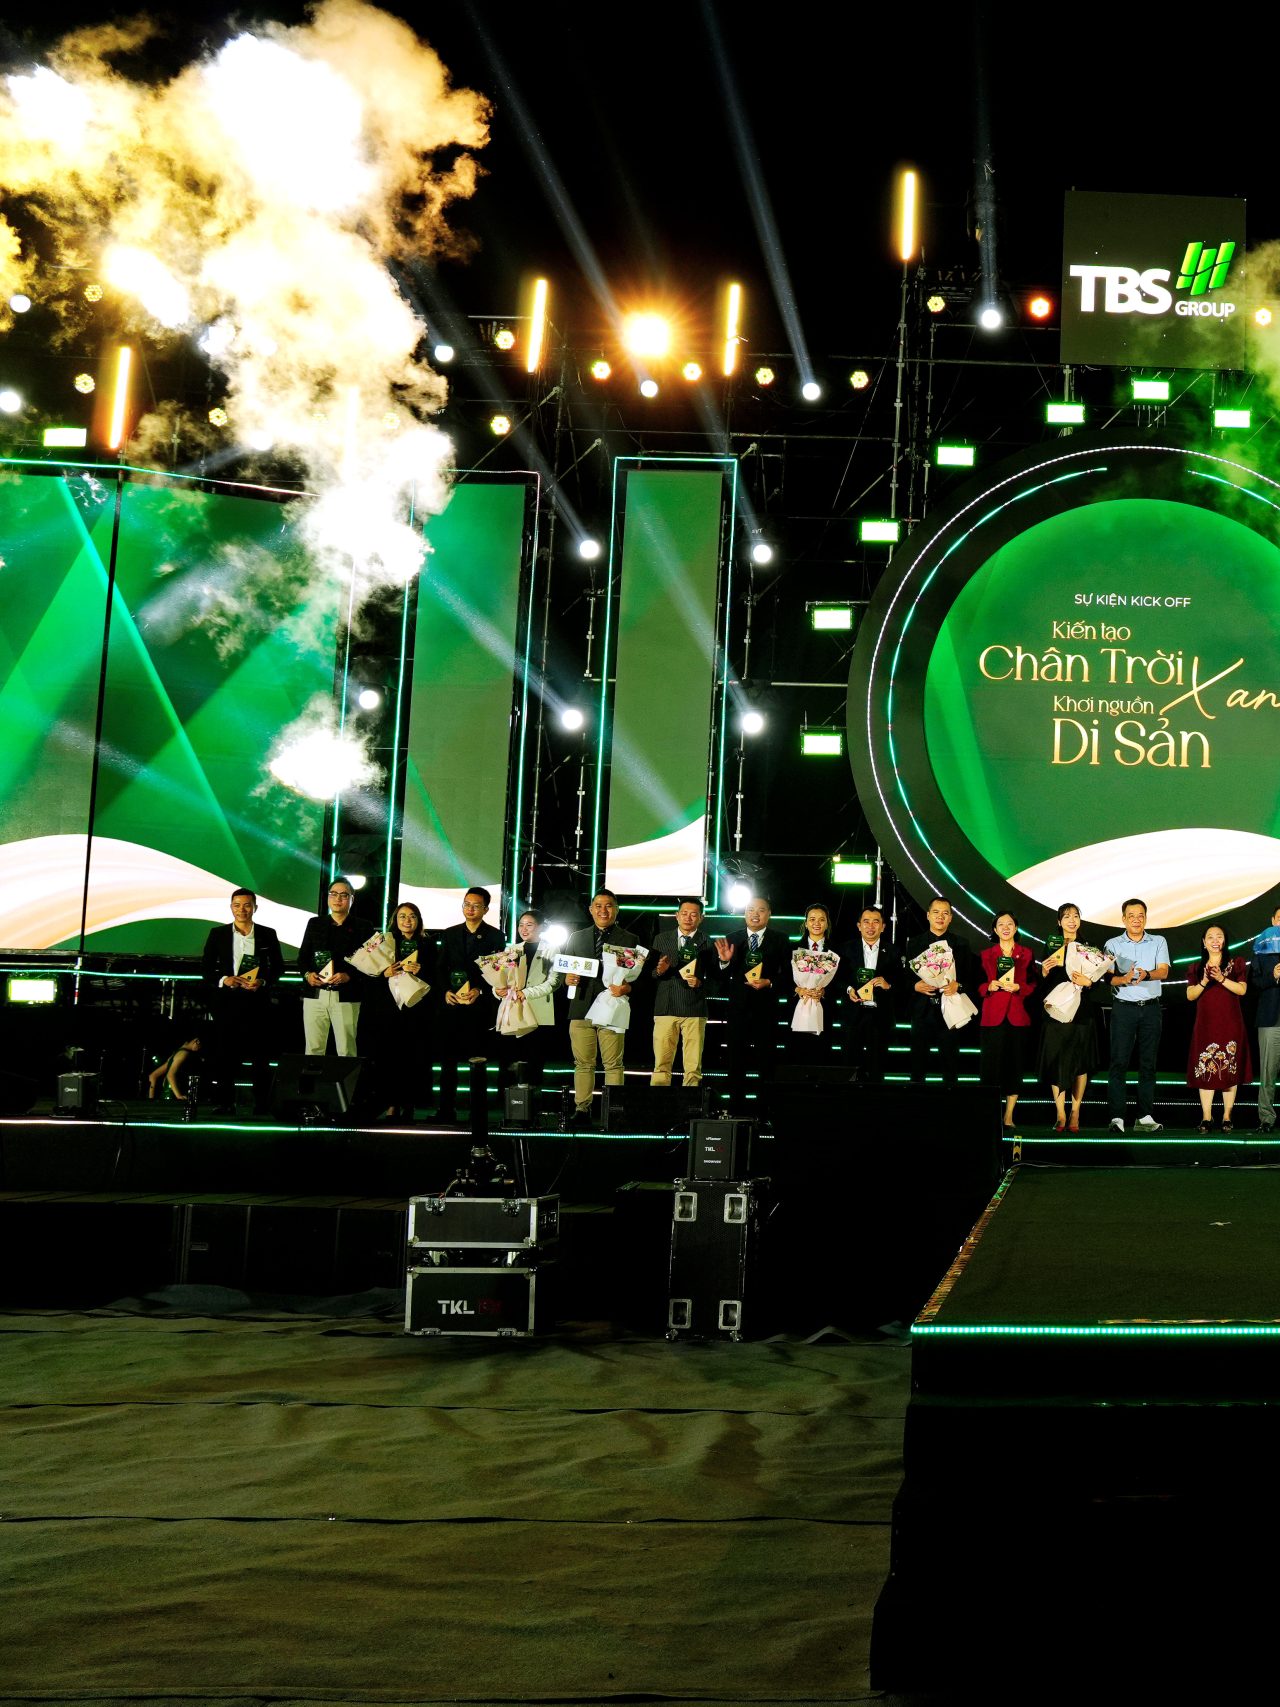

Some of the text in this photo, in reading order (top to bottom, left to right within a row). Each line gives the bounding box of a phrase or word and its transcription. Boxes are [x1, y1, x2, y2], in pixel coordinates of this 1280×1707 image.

[1069, 264, 1236, 317] TBS GROUP
[1074, 593, 1192, 608] SỰ KIỆN KICK OFF
[1052, 620, 1131, 643] Kiến tạo
[978, 644, 1090, 683] Chân
[1100, 648, 1184, 686] Trời
[1053, 695, 1155, 717] Khơi nguồn
[1051, 717, 1212, 769] Di Sản
[558, 957, 569, 968] ta
[437, 1299, 475, 1315] TKL
